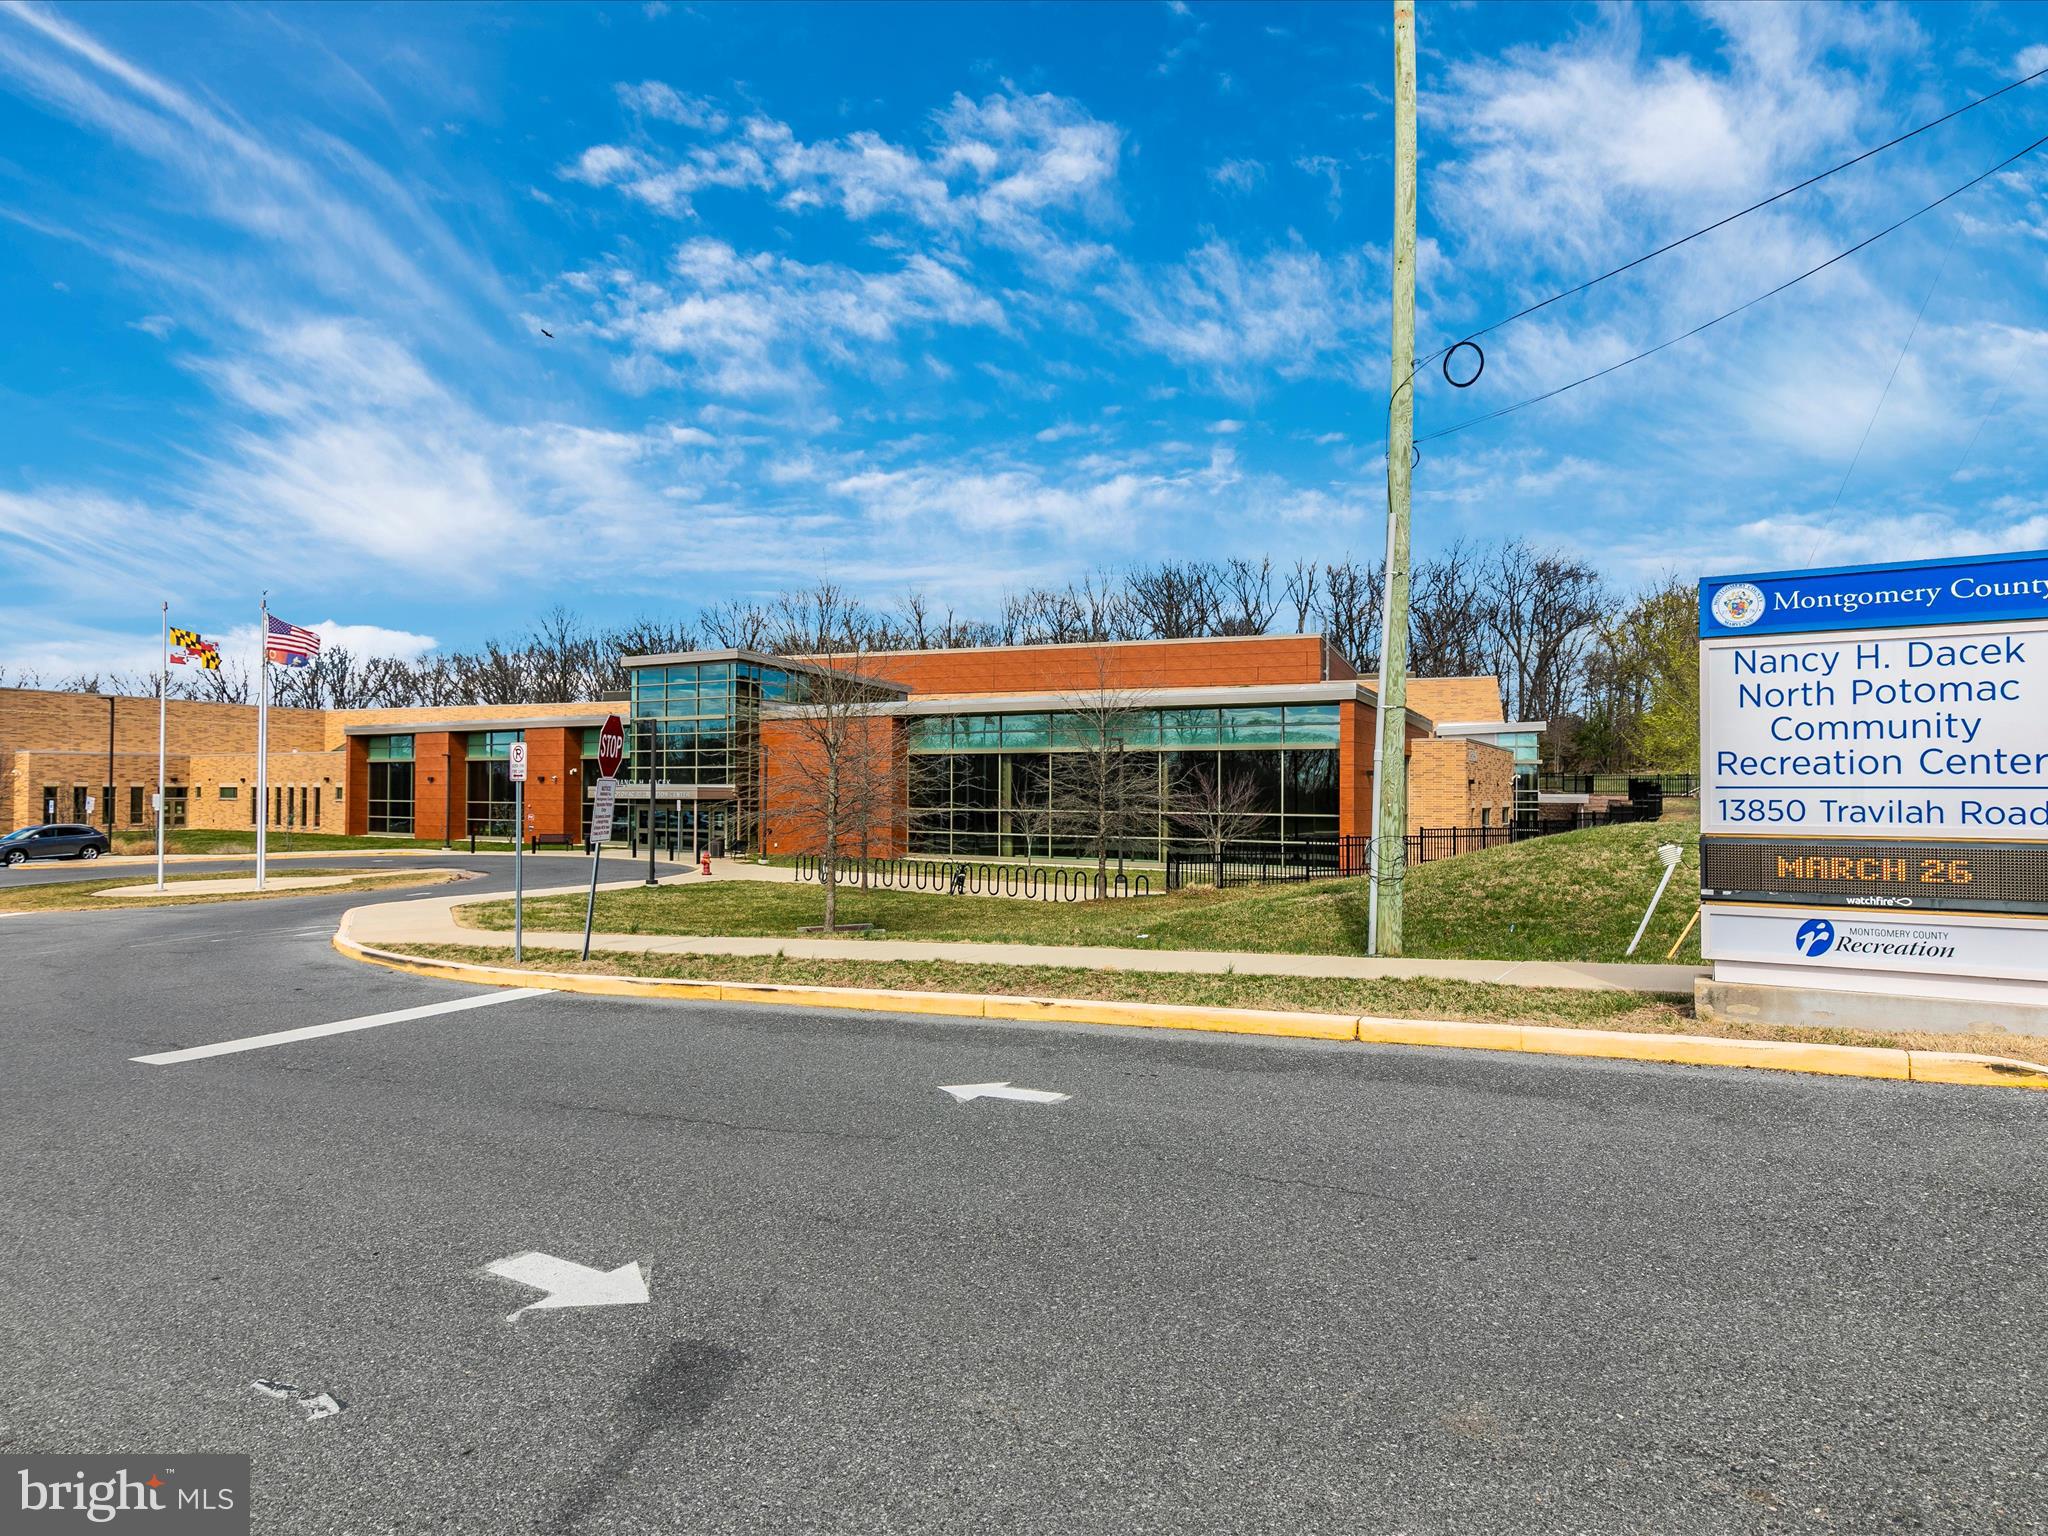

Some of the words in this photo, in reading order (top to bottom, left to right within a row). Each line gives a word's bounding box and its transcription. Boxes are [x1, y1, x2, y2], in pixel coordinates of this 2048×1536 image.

[1773, 586, 1941, 612] Montgomery
[1734, 650, 1839, 676] Nancy
[1857, 644, 1889, 669] H.
[1908, 636, 2025, 667] Dacek
[1739, 681, 1834, 707] North
[1852, 678, 2020, 704] Potomac
[1771, 712, 1981, 743] Community
[600, 734, 623, 758] STOP
[1718, 750, 1902, 775] Recreation
[1919, 748, 2048, 774] Center
[1718, 799, 1806, 821] 13850
[1820, 800, 1944, 824] Travilah
[1961, 800, 2048, 825] Road
[1777, 856, 1906, 881] MARCH
[1920, 859, 1972, 884] 26
[1846, 896, 1894, 906] watchfire
[1835, 936, 1955, 958] Recreation
[1849, 928, 1910, 938] MONTGOMERY
[1913, 931, 1949, 940] COUNTY
